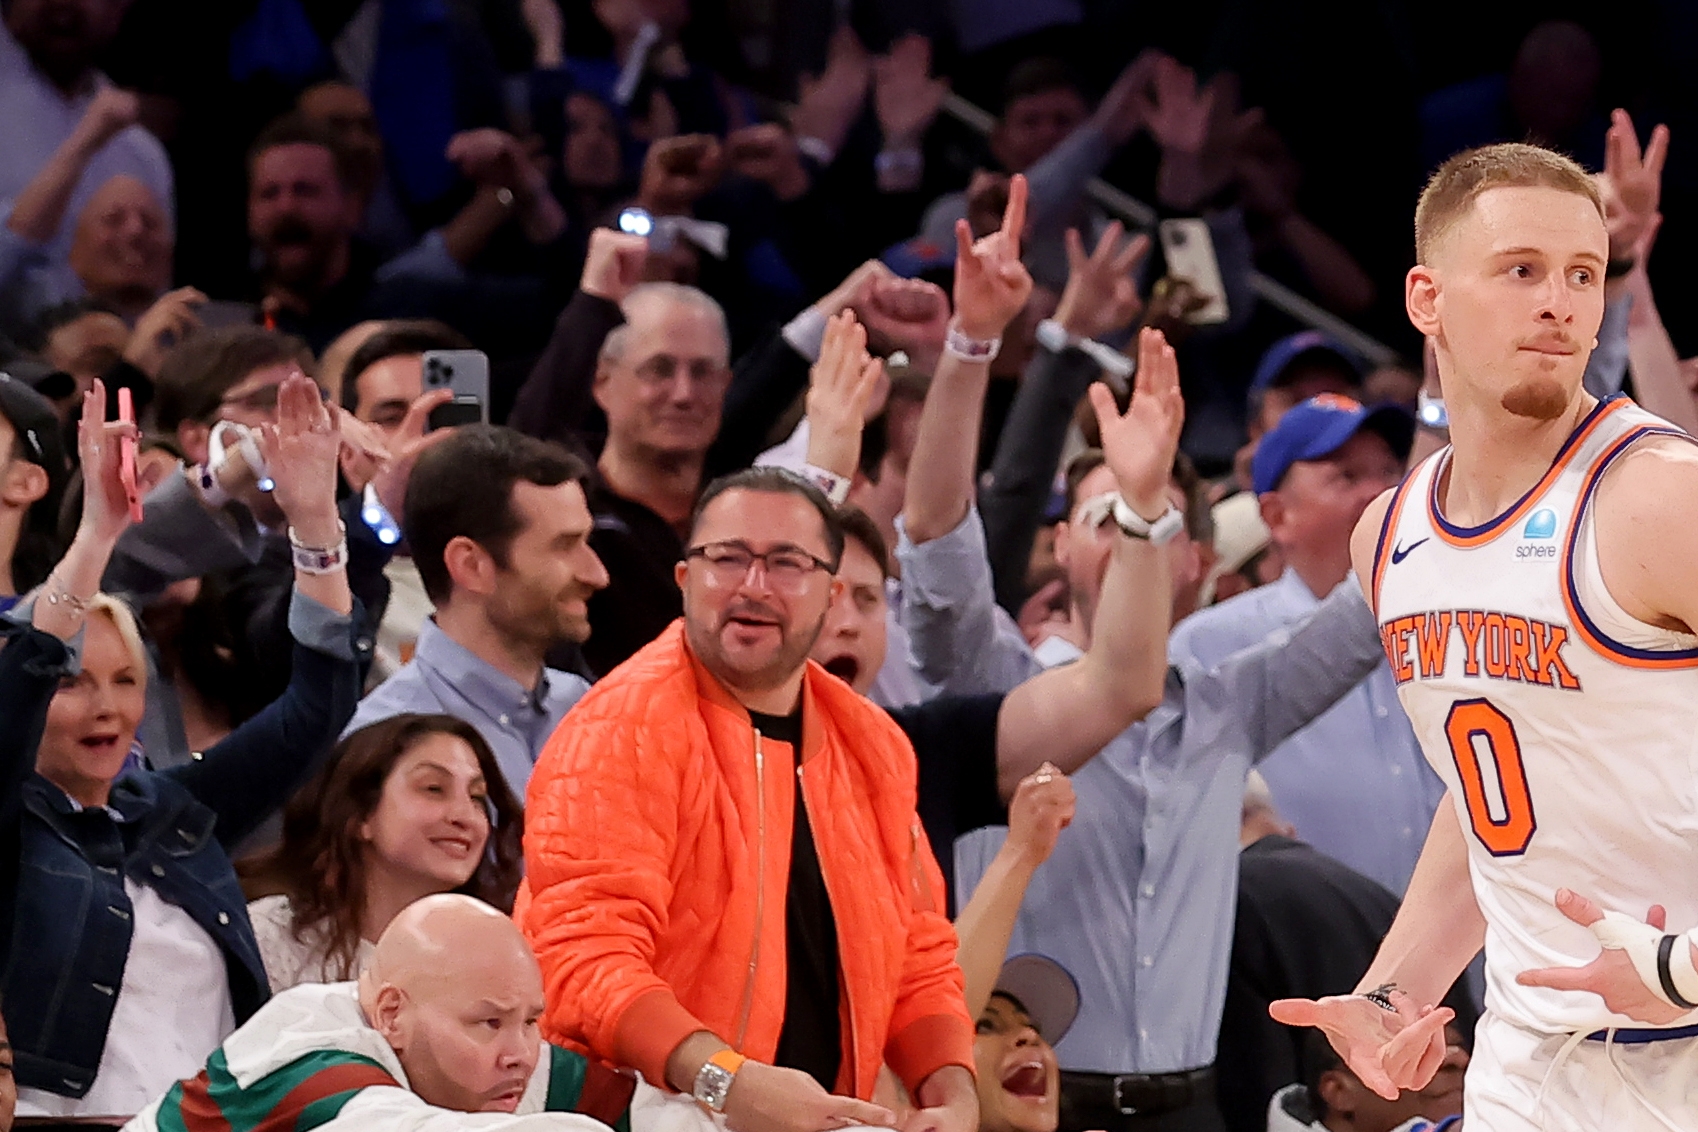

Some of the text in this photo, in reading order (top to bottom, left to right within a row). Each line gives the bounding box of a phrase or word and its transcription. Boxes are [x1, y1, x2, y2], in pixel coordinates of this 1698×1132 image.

[1516, 543, 1556, 560] sphere
[1380, 611, 1582, 691] NEW YORK
[1444, 697, 1537, 857] 0
